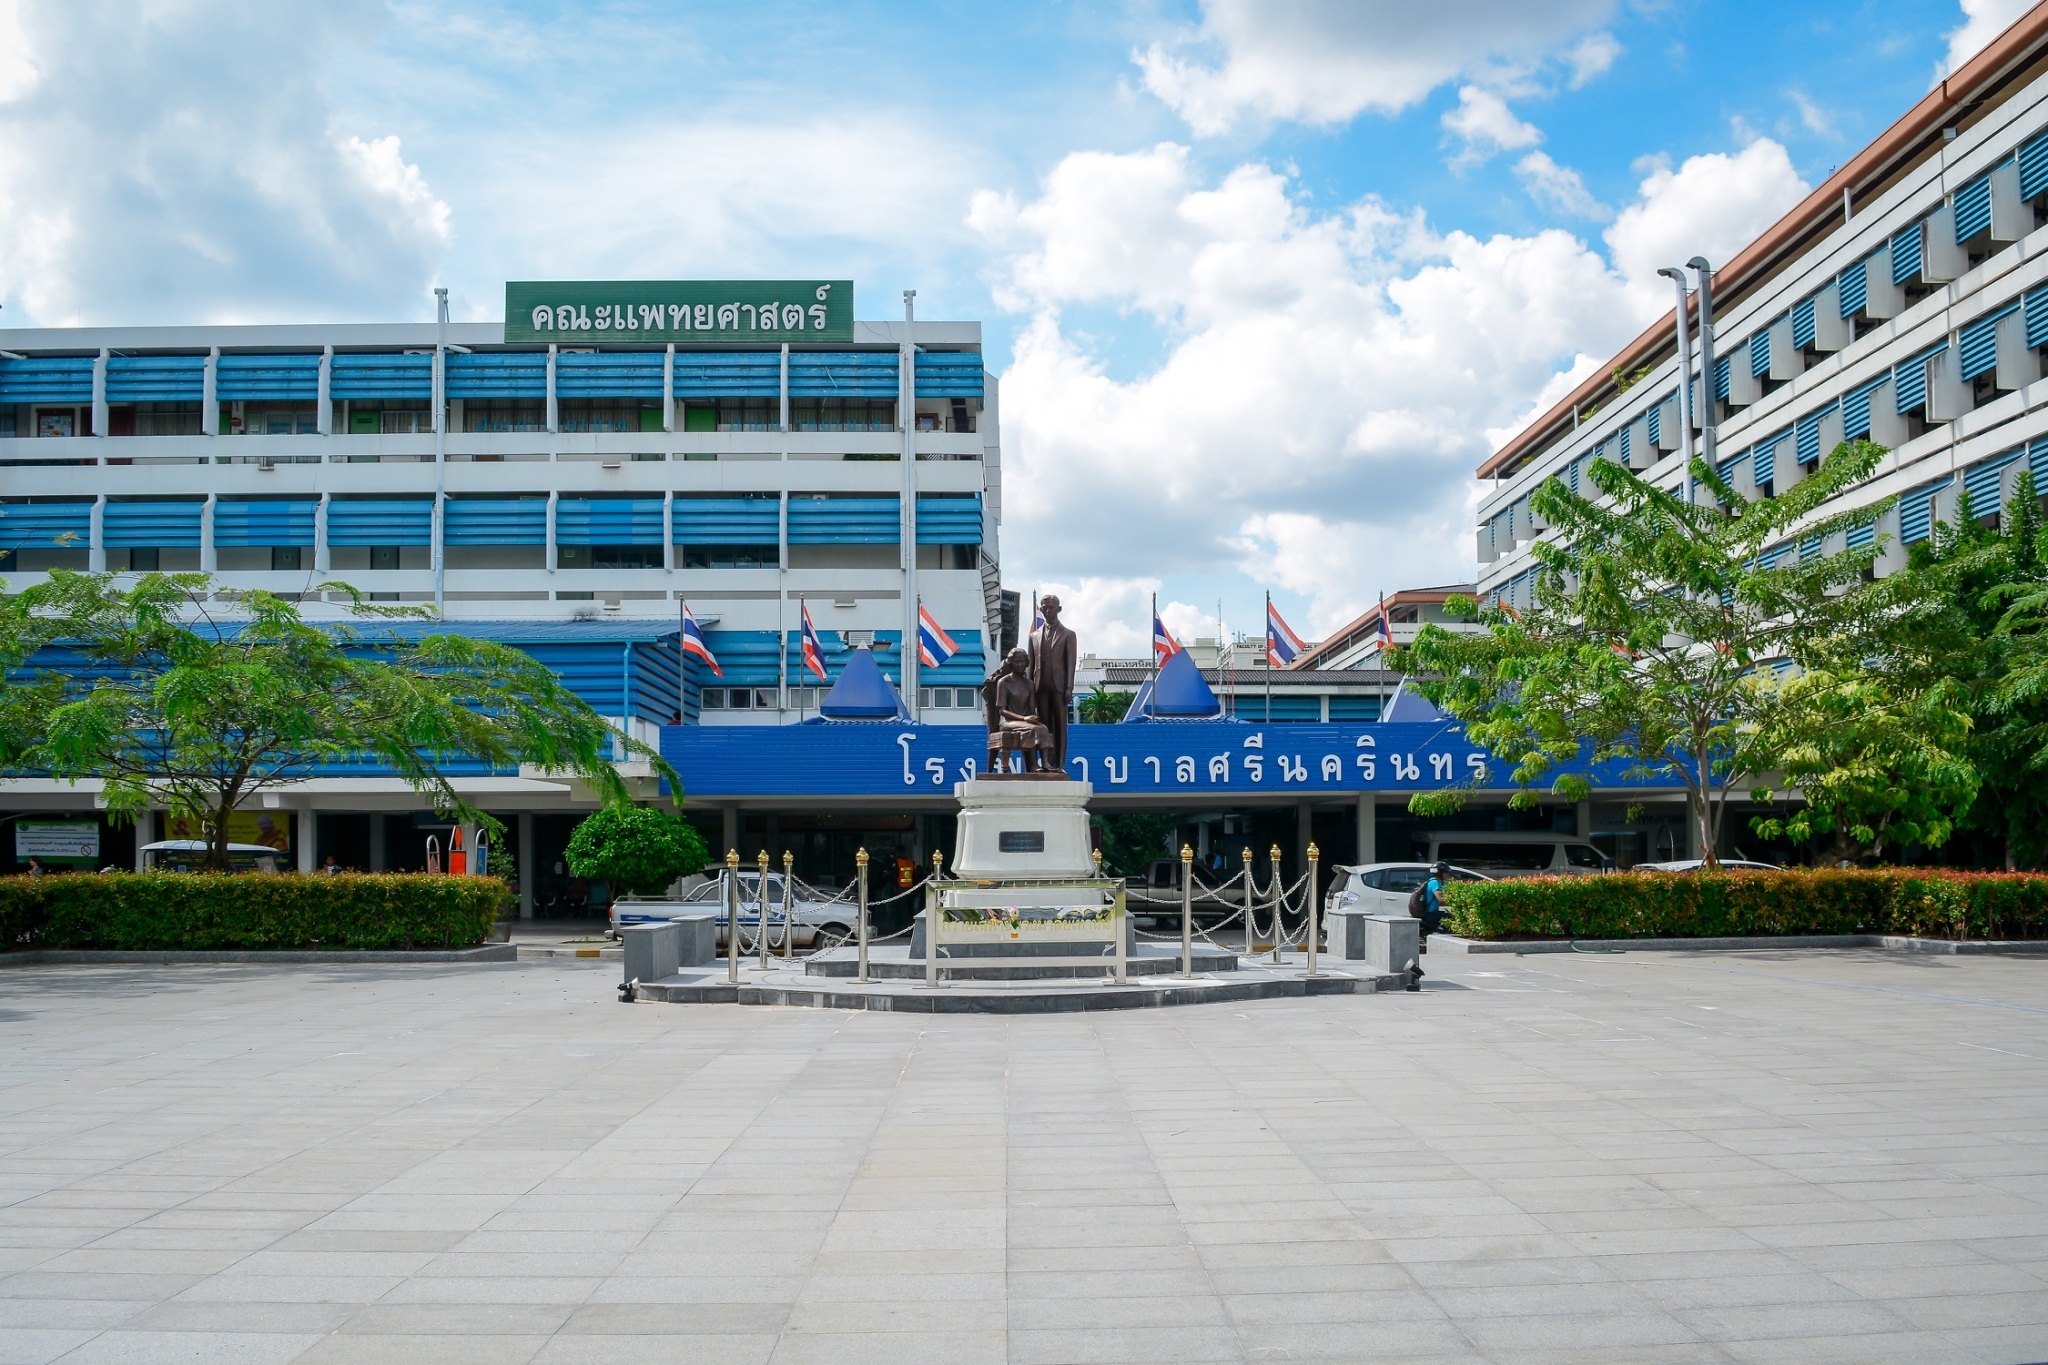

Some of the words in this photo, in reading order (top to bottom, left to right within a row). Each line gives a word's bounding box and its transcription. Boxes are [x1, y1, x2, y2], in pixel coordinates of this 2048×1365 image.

[531, 283, 831, 332] คณะแพทยศาสตร์
